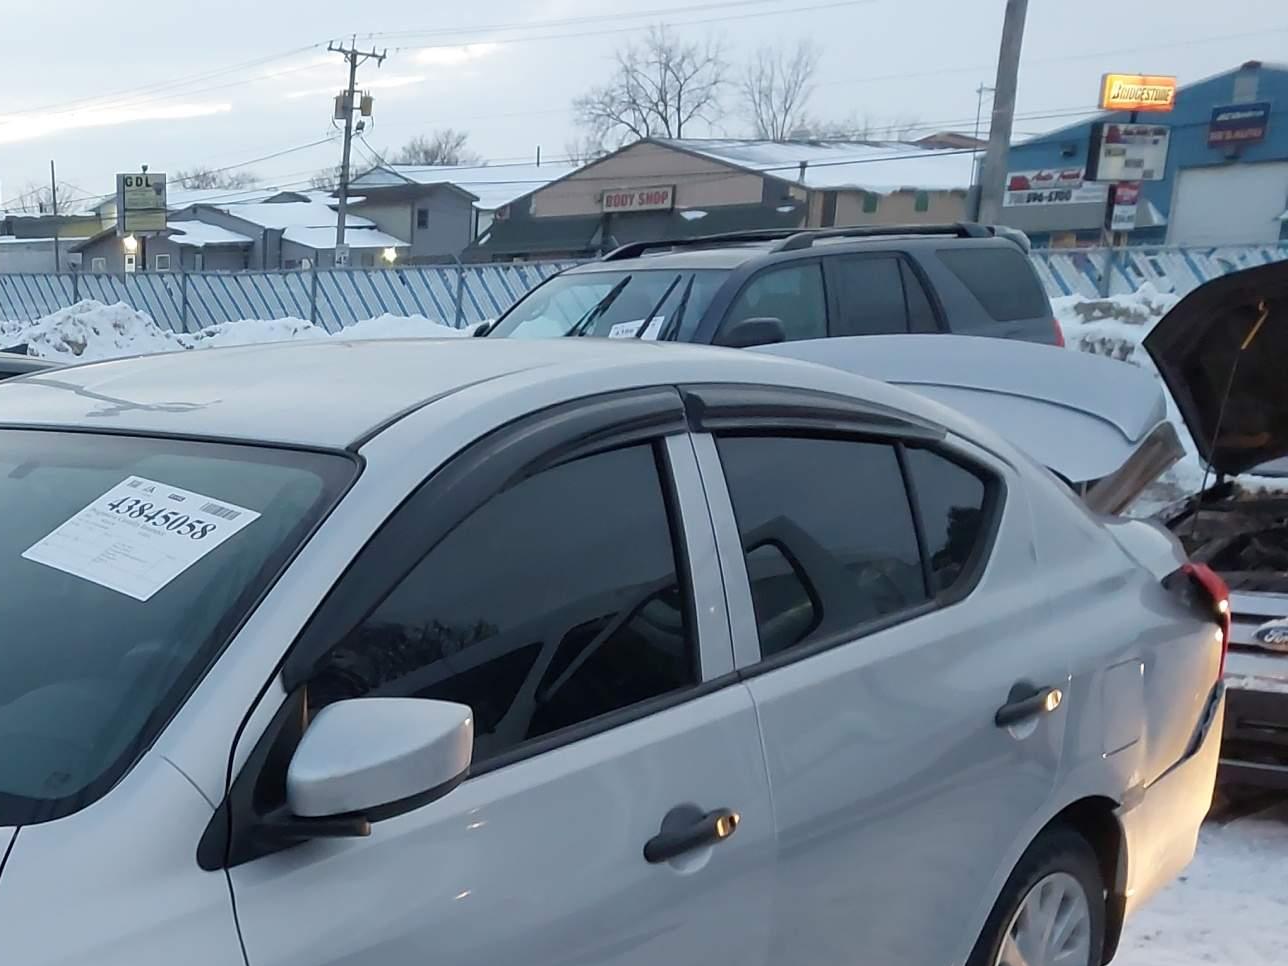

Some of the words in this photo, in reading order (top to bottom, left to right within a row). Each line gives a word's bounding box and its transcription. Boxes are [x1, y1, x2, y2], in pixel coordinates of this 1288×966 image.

[1112, 84, 1173, 101] BRIDGESTONE
[606, 193, 635, 208] BODY
[638, 191, 669, 206] SHOP
[108, 496, 217, 540] 43845058
